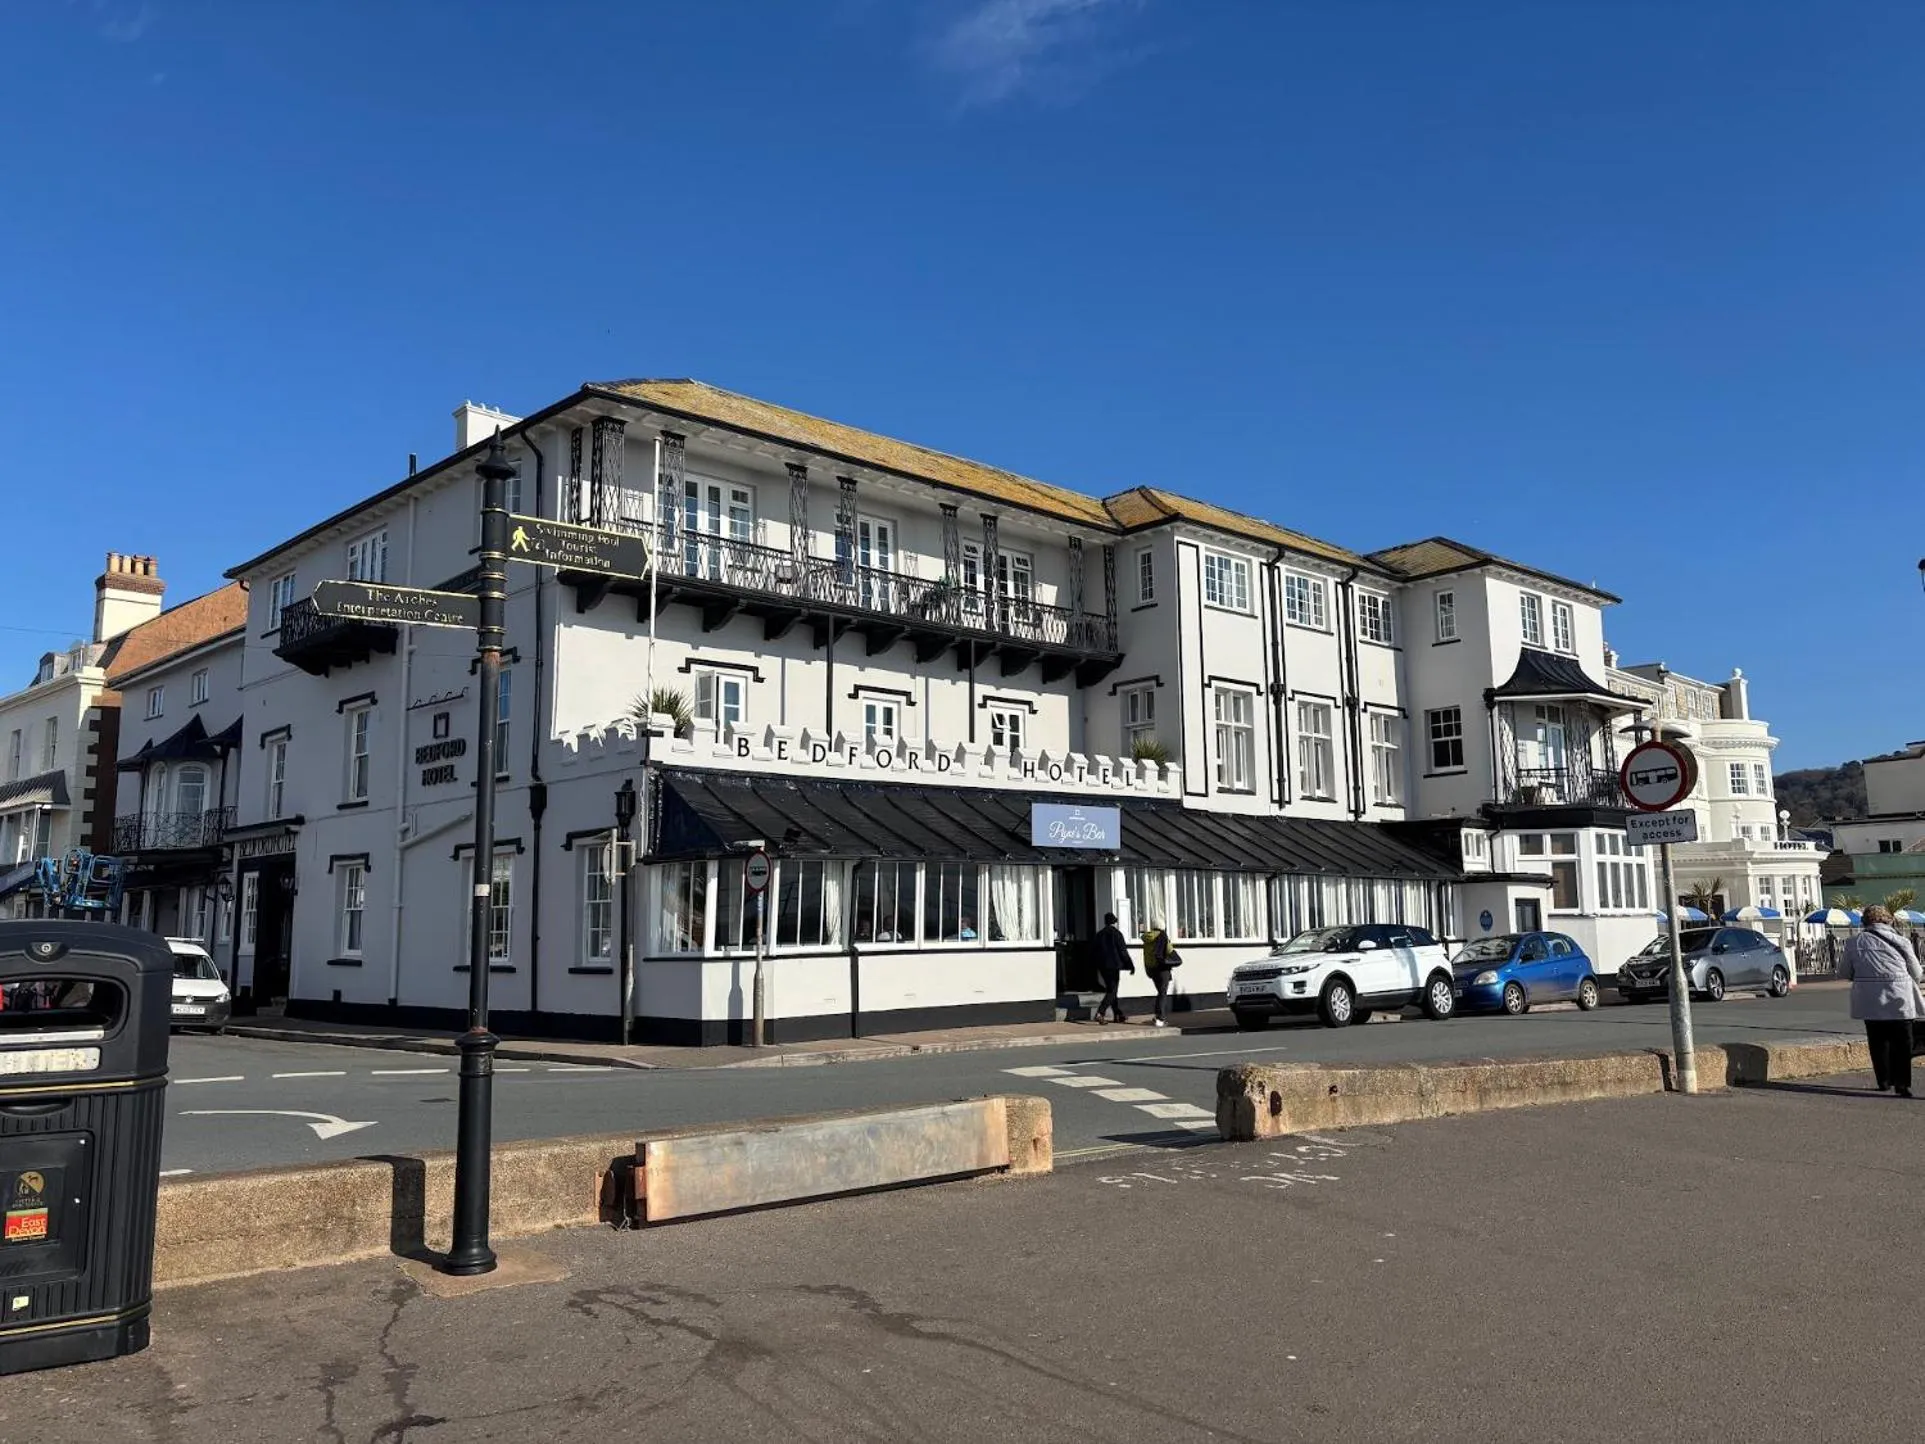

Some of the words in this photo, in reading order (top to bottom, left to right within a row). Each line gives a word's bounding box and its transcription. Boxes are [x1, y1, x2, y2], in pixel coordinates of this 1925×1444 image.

[545, 548, 612, 569] Information
[367, 588, 391, 602] The
[394, 593, 438, 607] Arches
[336, 601, 421, 620] Interpretation
[424, 609, 464, 624] Centre
[415, 738, 467, 765] BEDFORD
[736, 737, 951, 772] BEDFORD
[1023, 761, 1134, 786] HOTEL
[421, 764, 458, 787] HOTEL
[1630, 817, 1670, 829] Except
[1672, 815, 1689, 826] for
[1082, 822, 1106, 841] Bar
[1641, 829, 1682, 840] access
[1773, 841, 1809, 850] HOTEL
[21, 1217, 46, 1228] East
[8, 1226, 46, 1237] Devon
